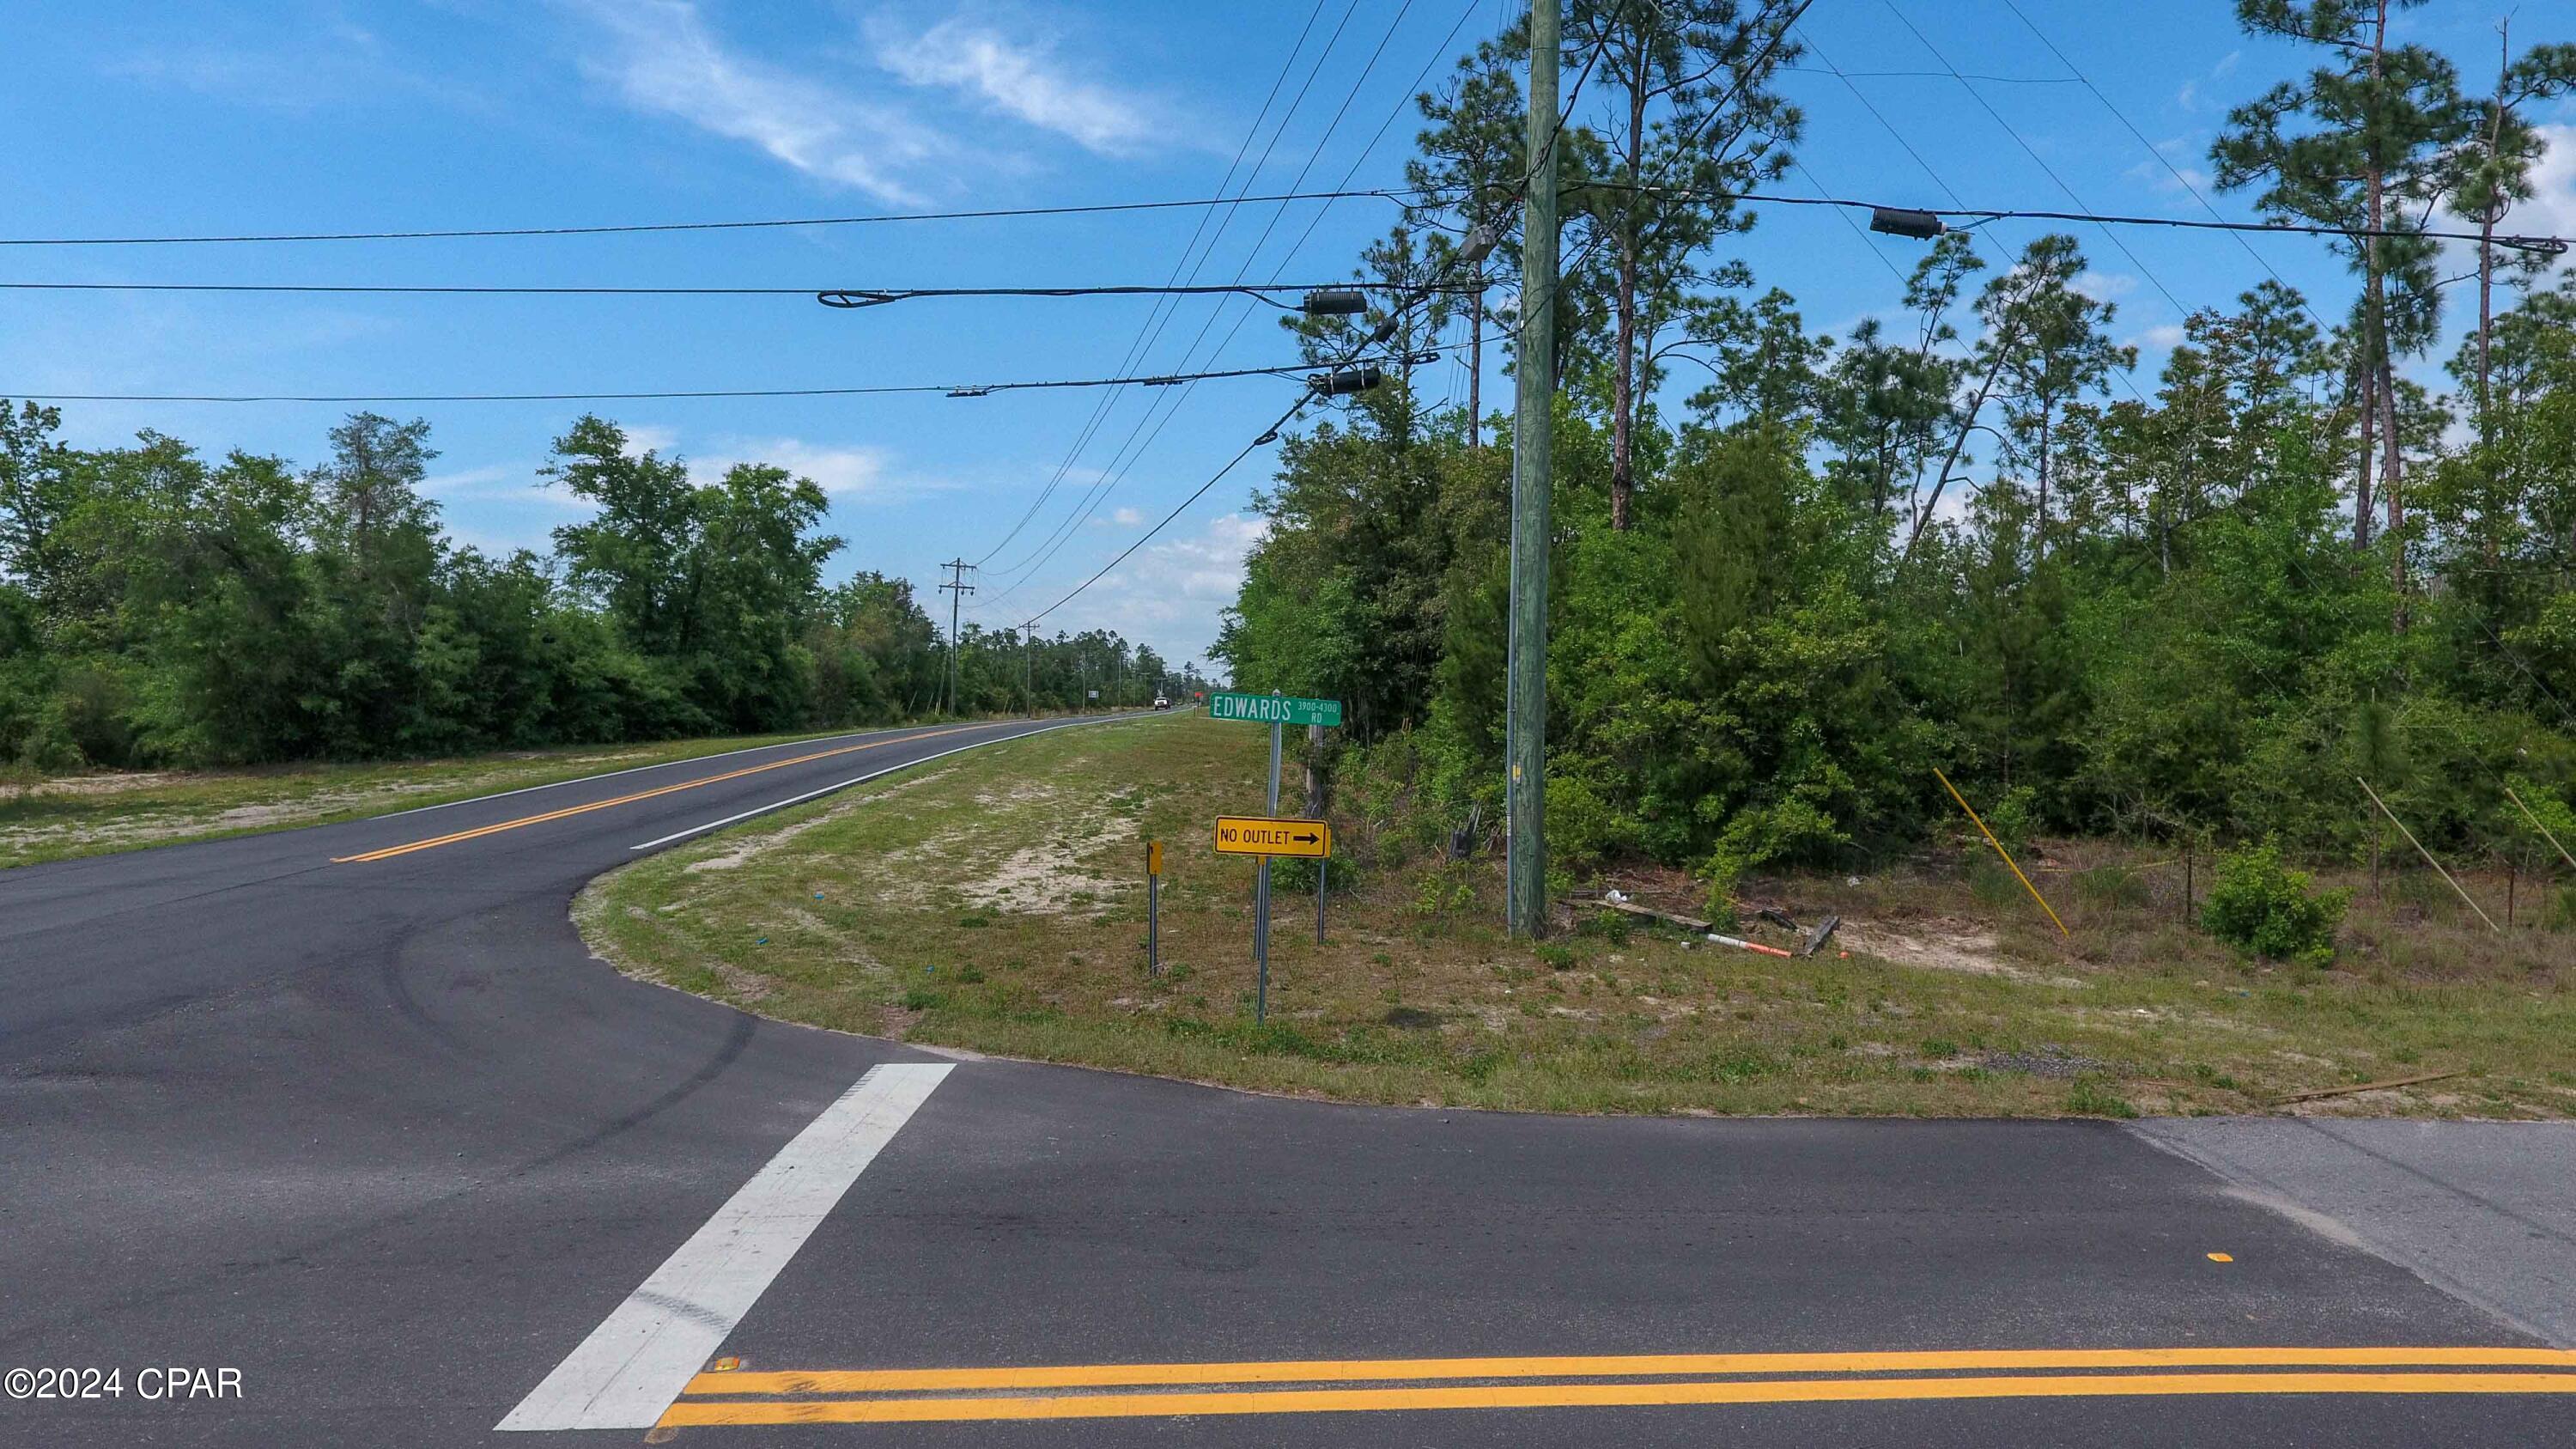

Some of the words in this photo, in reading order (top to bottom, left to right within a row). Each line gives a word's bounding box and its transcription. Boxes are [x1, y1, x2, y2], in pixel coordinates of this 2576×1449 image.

[1213, 697, 1291, 721] EDWARDS
[1311, 713, 1322, 723] RD
[1220, 828, 1237, 843] NO
[1242, 829, 1290, 845] OUTLET
